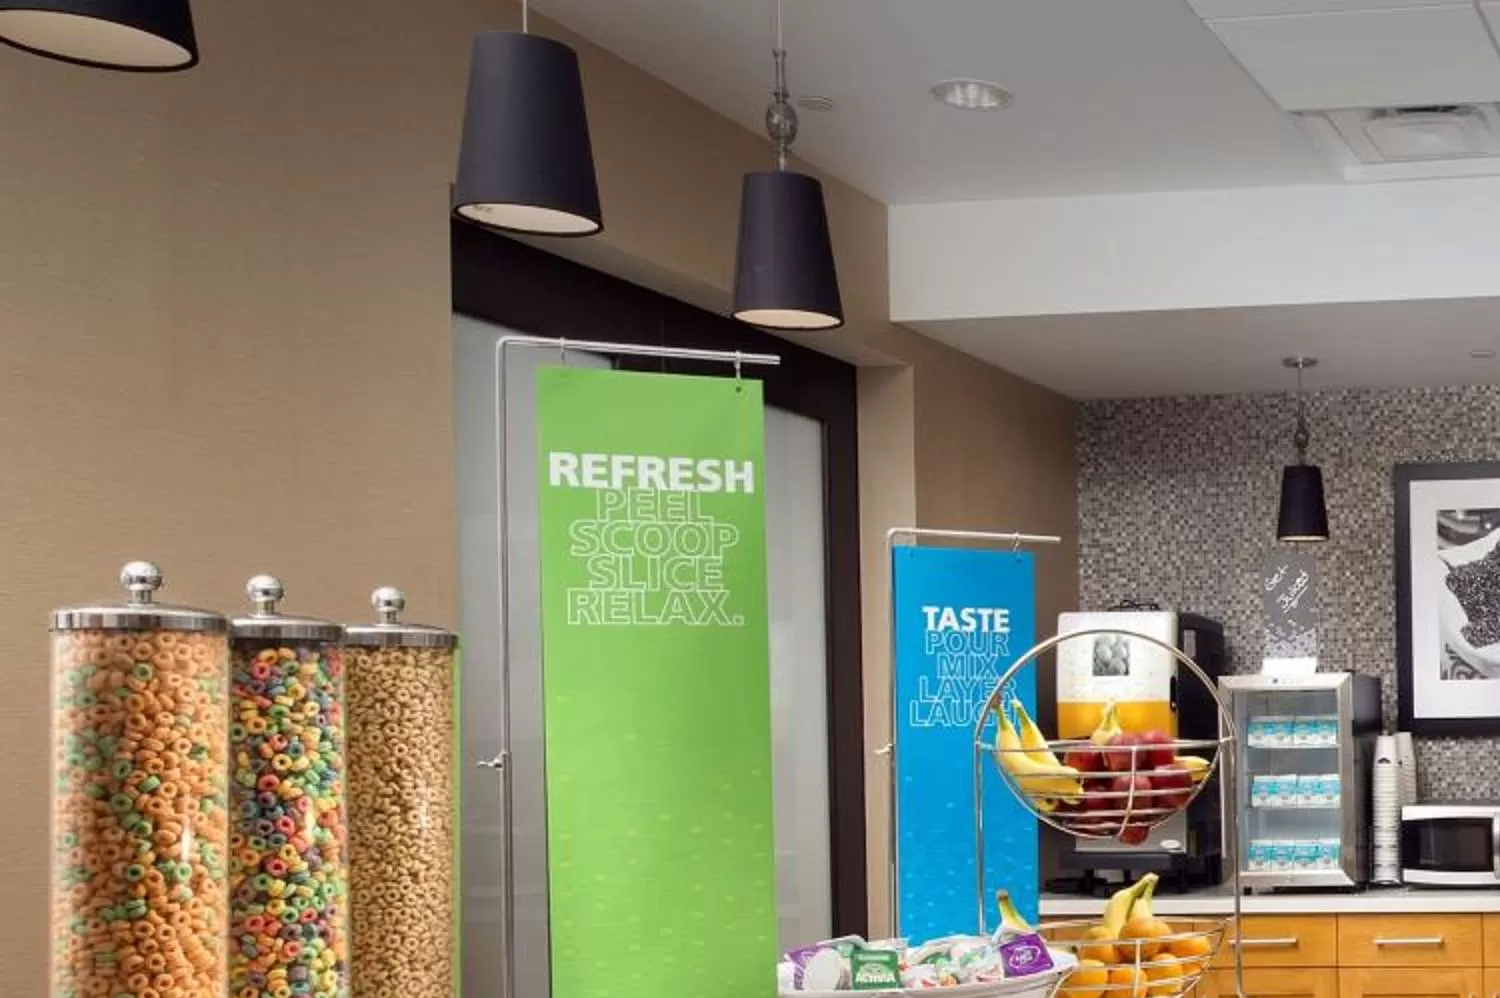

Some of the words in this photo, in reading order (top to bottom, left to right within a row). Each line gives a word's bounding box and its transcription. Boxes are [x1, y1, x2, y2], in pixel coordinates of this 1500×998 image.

[549, 451, 754, 494] REFRESH
[596, 487, 714, 525] PEEL
[568, 519, 739, 558] SCOOP
[587, 554, 724, 593] SLICE
[567, 587, 744, 626] RELAX.
[921, 605, 1011, 633] TASTE
[925, 630, 1010, 656] POUR
[937, 653, 999, 680] MIX
